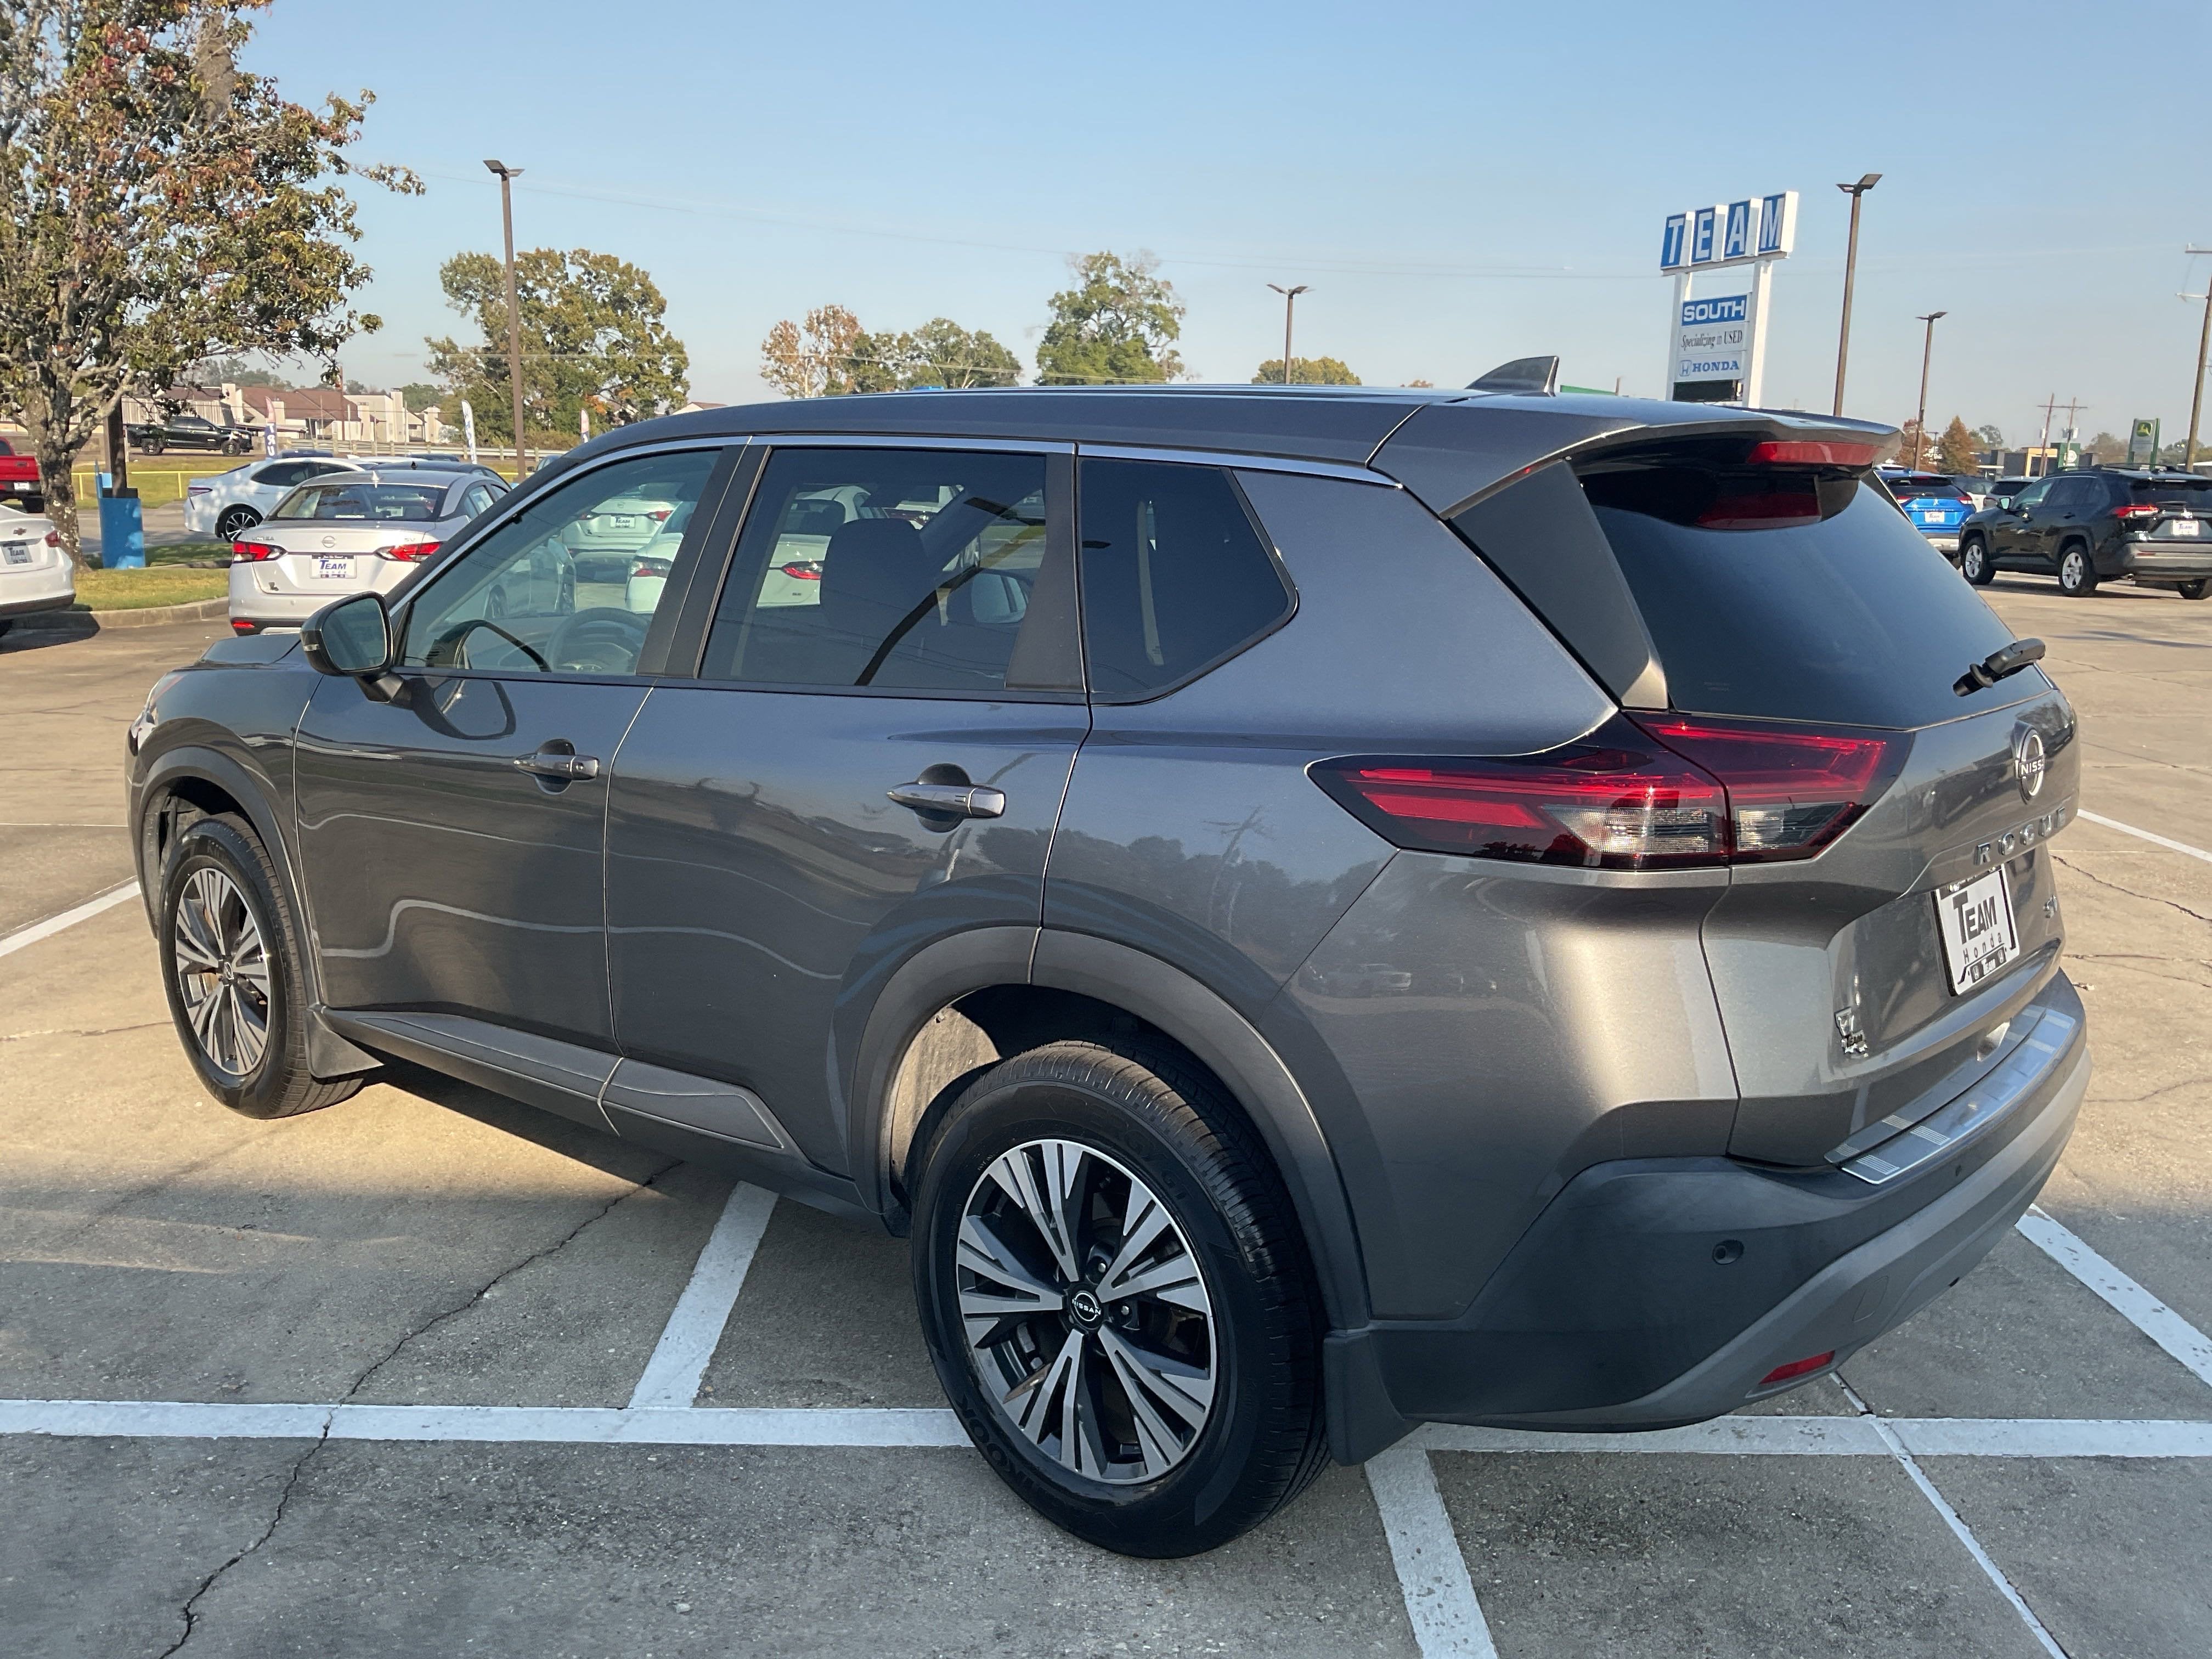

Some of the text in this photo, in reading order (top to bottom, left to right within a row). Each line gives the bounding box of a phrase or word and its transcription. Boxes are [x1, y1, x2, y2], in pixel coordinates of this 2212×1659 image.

[1668, 198, 1785, 263] TEAM
[1683, 300, 1745, 321] SOUTH
[1681, 333, 1716, 351] Specializing
[1724, 330, 1742, 345] USED
[1692, 360, 1739, 372] HONDA
[320, 560, 347, 569] TEAM
[2021, 759, 2045, 776] NISS
[1953, 890, 1997, 944] TEAM
[1963, 932, 2002, 963] Honda
[1071, 1298, 1101, 1315] NISSAN
